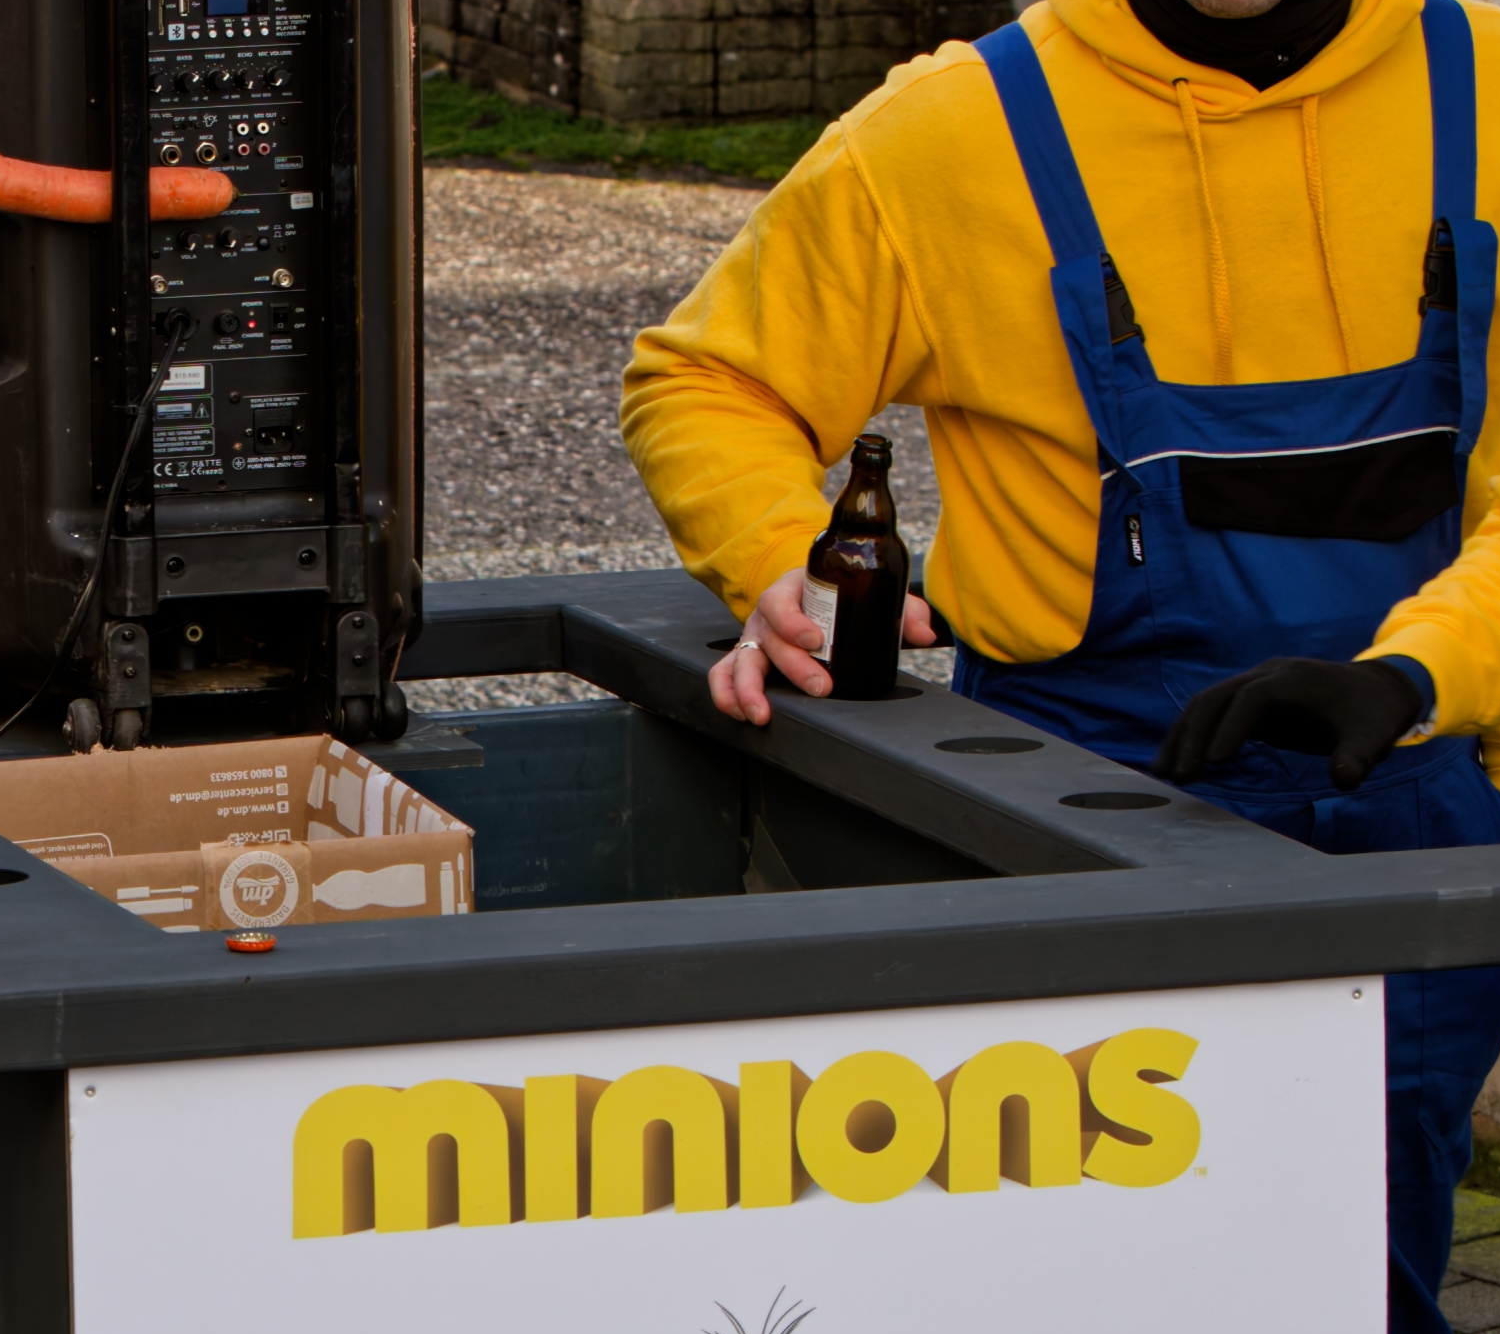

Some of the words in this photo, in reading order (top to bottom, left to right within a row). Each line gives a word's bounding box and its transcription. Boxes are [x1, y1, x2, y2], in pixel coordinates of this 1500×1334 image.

[210, 770, 249, 782] 3658633
[250, 768, 273, 779] 0800
[169, 786, 274, 804] servicecenter@dm.de
[217, 803, 275, 818] www.dm.de
[234, 855, 251, 871] SEIT
[259, 852, 295, 884] GARANTIE
[242, 885, 275, 906] dm
[230, 905, 290, 927] DAUERPREIS
